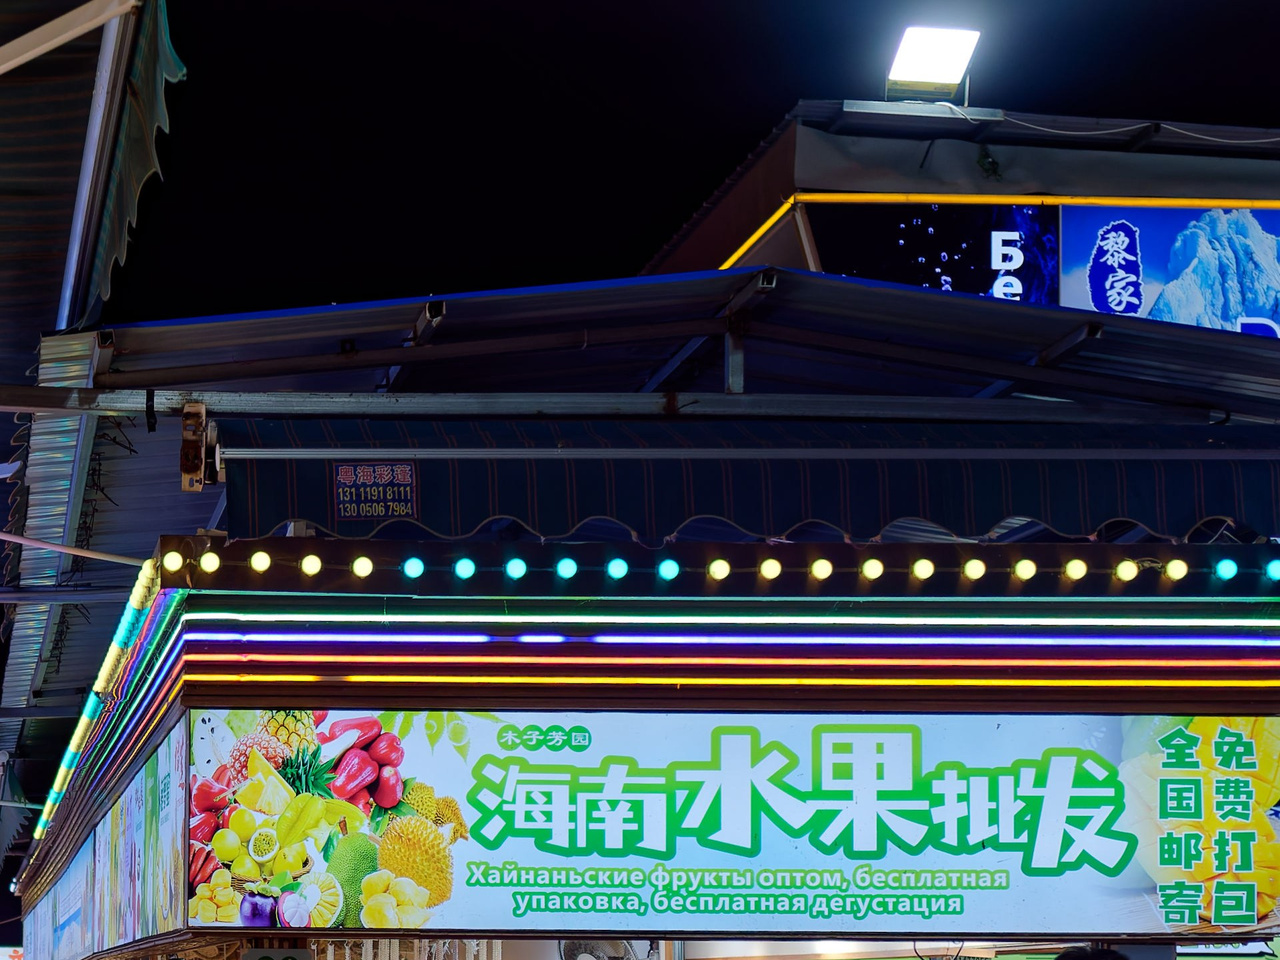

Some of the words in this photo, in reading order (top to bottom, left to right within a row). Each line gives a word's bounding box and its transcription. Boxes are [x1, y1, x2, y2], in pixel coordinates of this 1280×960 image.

[1099, 231, 1140, 311] 黎家
[338, 487, 356, 502] 131
[359, 486, 384, 501] 1191
[386, 486, 411, 500] 8111
[339, 503, 358, 517] 130
[360, 502, 385, 516] 0506
[387, 502, 412, 516] 7984
[498, 727, 591, 749] 木子芳园
[474, 730, 1131, 871] 海南水果批发
[1158, 726, 1203, 926] 全国邮寄
[1213, 726, 1258, 926] 免费打包
[469, 864, 643, 886] Хайнаньские
[651, 867, 751, 891] фрукты
[759, 872, 847, 890] оптом,
[856, 866, 1008, 888] бесплатная
[514, 893, 646, 914] упаковка,
[654, 891, 806, 911] бесплатная
[813, 893, 962, 917] дегустация
